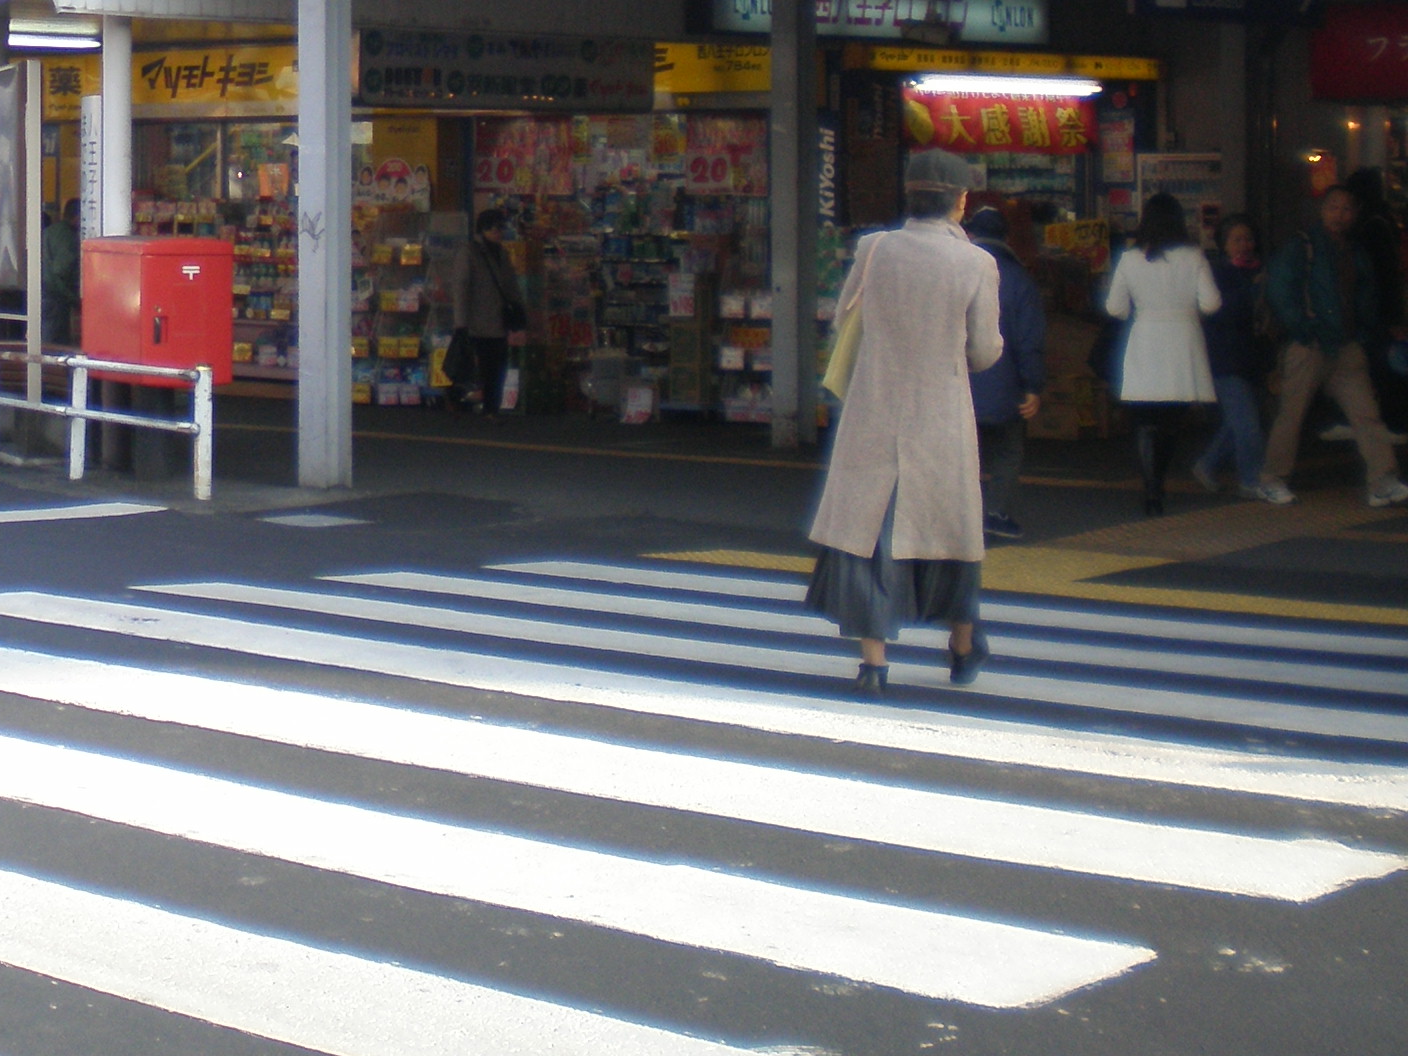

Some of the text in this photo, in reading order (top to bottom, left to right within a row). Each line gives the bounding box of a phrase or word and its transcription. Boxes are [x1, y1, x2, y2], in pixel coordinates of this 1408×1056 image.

[48, 66, 82, 96] 薬
[142, 54, 274, 98] マツモトキヨシ
[940, 103, 1088, 148] 大感謝祭
[690, 156, 728, 183] 20
